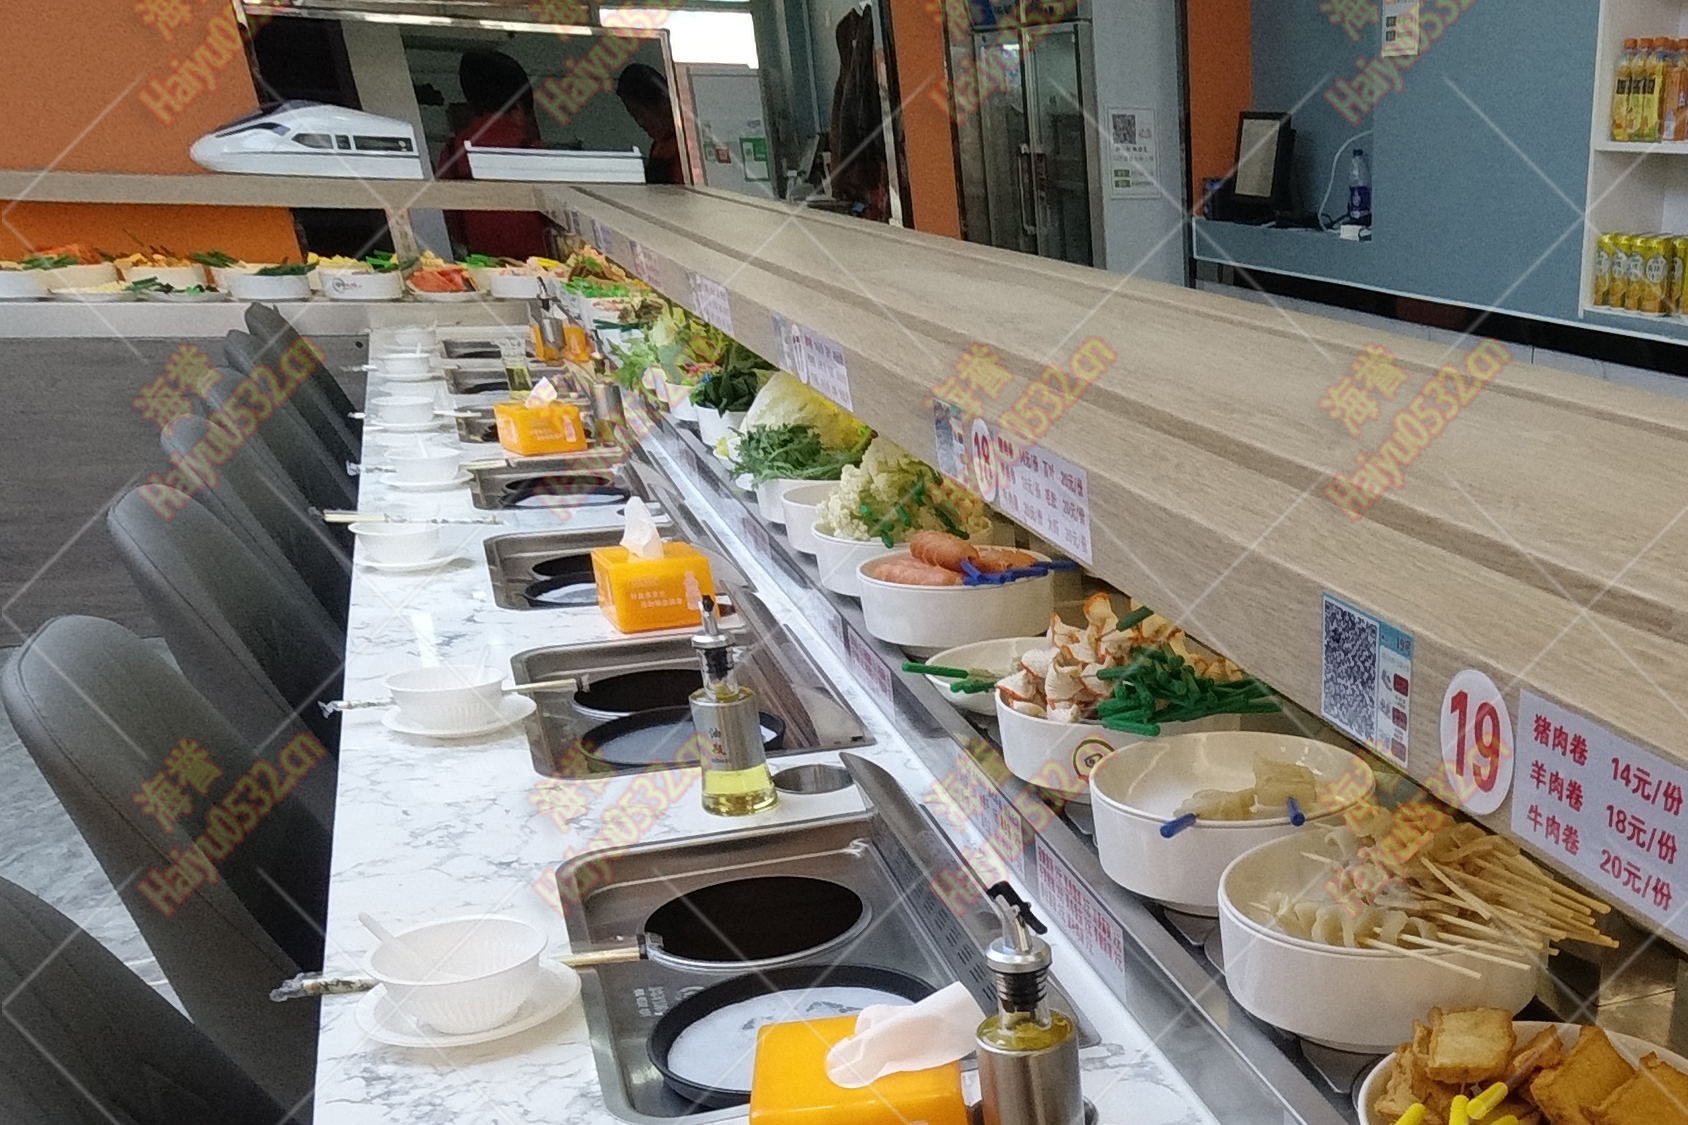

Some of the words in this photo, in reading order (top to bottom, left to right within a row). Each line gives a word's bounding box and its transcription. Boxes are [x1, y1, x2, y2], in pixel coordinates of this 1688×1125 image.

[1449, 690, 1500, 793] 19
[1533, 714, 1589, 766] 猪肉卷
[1611, 757, 1683, 816] 14元/份
[1526, 804, 1581, 856] 牛肉卷
[1600, 849, 1673, 911] 20元/份
[1530, 760, 1585, 812] 羊肉卷
[1606, 804, 1678, 864] 18元/份
